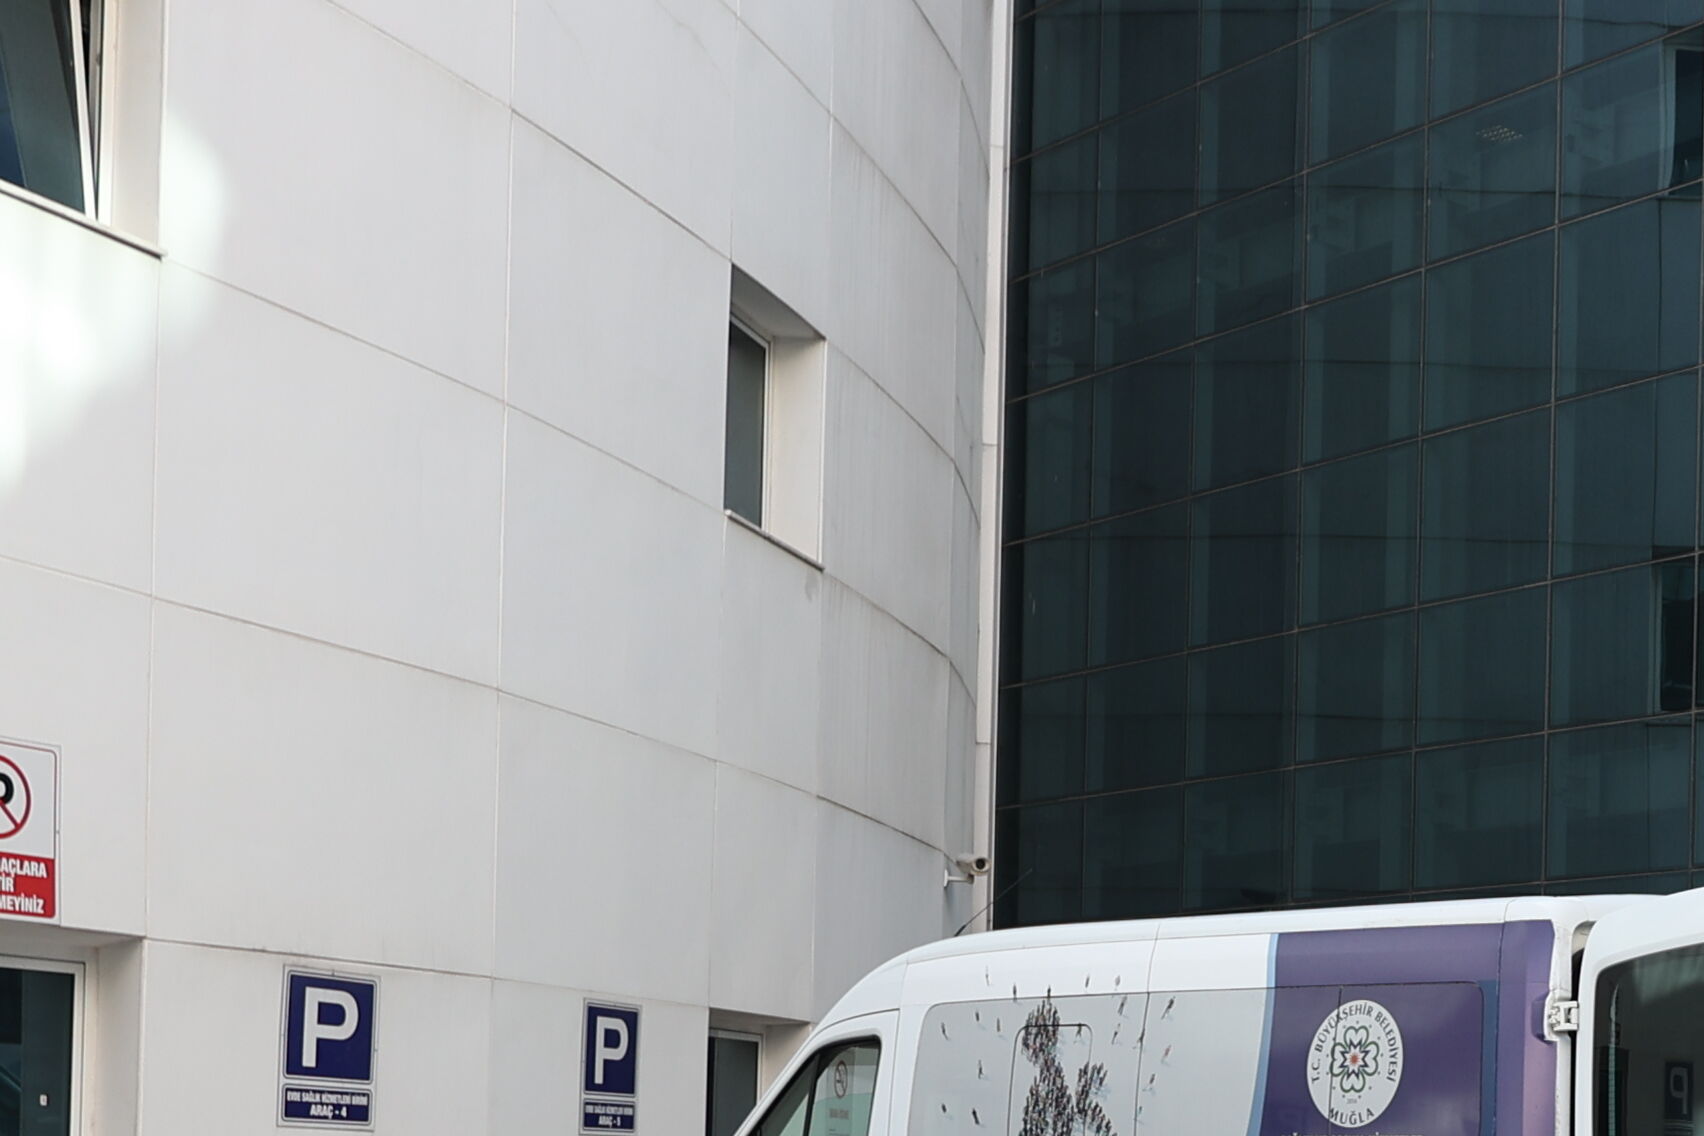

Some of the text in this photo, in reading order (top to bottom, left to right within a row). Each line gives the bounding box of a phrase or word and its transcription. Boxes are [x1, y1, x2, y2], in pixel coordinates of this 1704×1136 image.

[0, 857, 48, 878] AÇLARA
[0, 872, 15, 893] İR
[302, 986, 359, 1068] P
[594, 1016, 629, 1085] P
[310, 1104, 334, 1119] ARAÇ
[1329, 1108, 1375, 1126] MUĞLA
